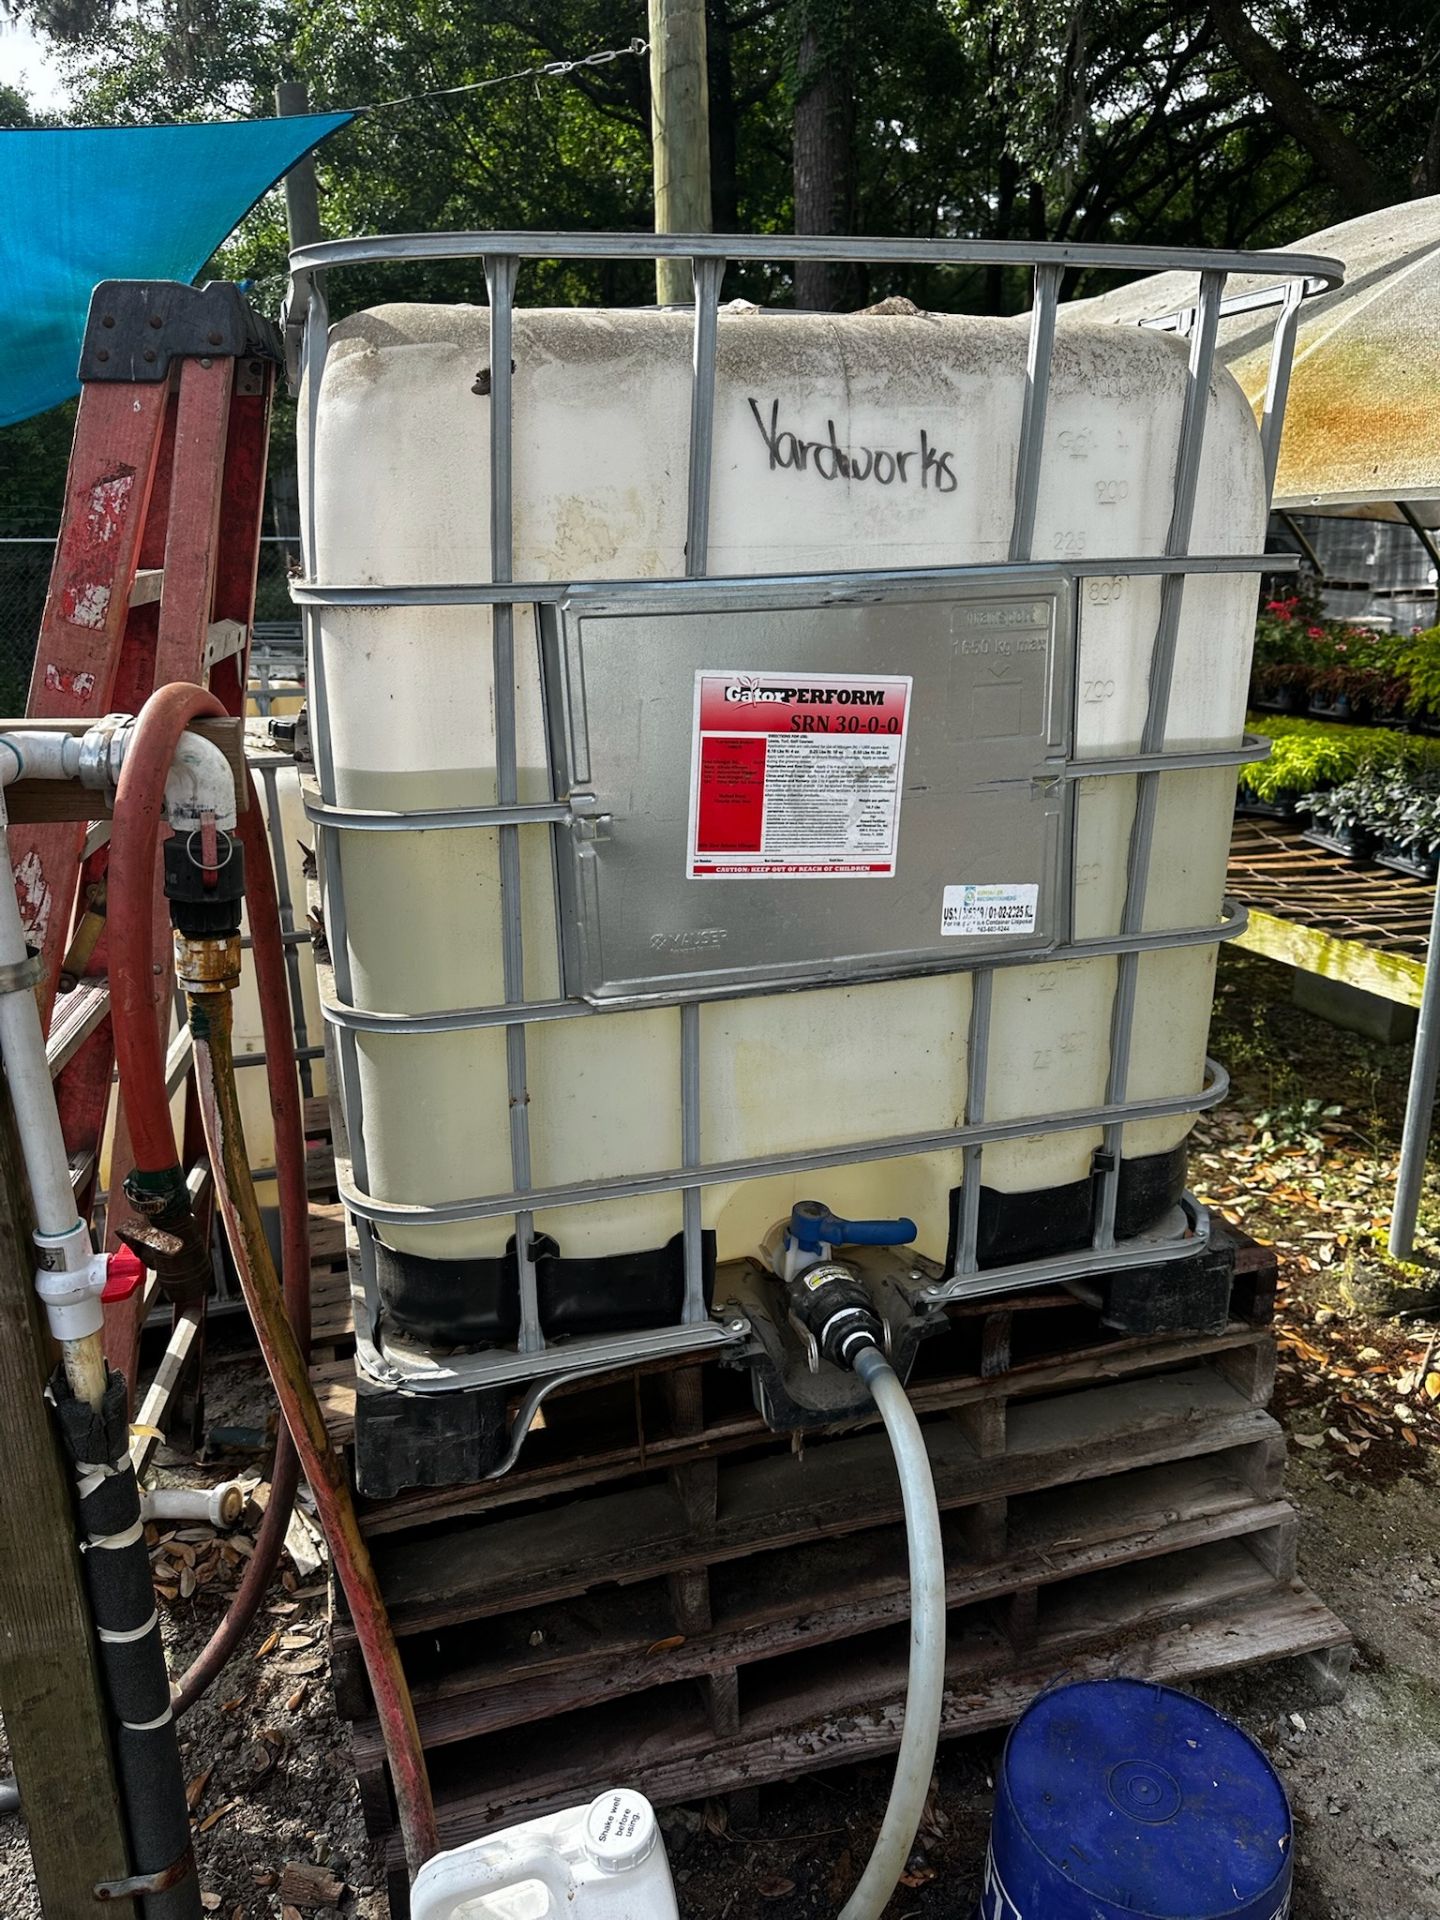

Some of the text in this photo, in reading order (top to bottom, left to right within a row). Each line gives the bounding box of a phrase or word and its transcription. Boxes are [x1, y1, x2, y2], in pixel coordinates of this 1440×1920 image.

[748, 397, 958, 493] Yardworks
[1095, 480, 1129, 500] 900
[790, 715, 899, 733] SRN 30-0-0
[598, 1796, 622, 1842] Shake well
[615, 1808, 632, 1837] before
[626, 1812, 640, 1838] using.
